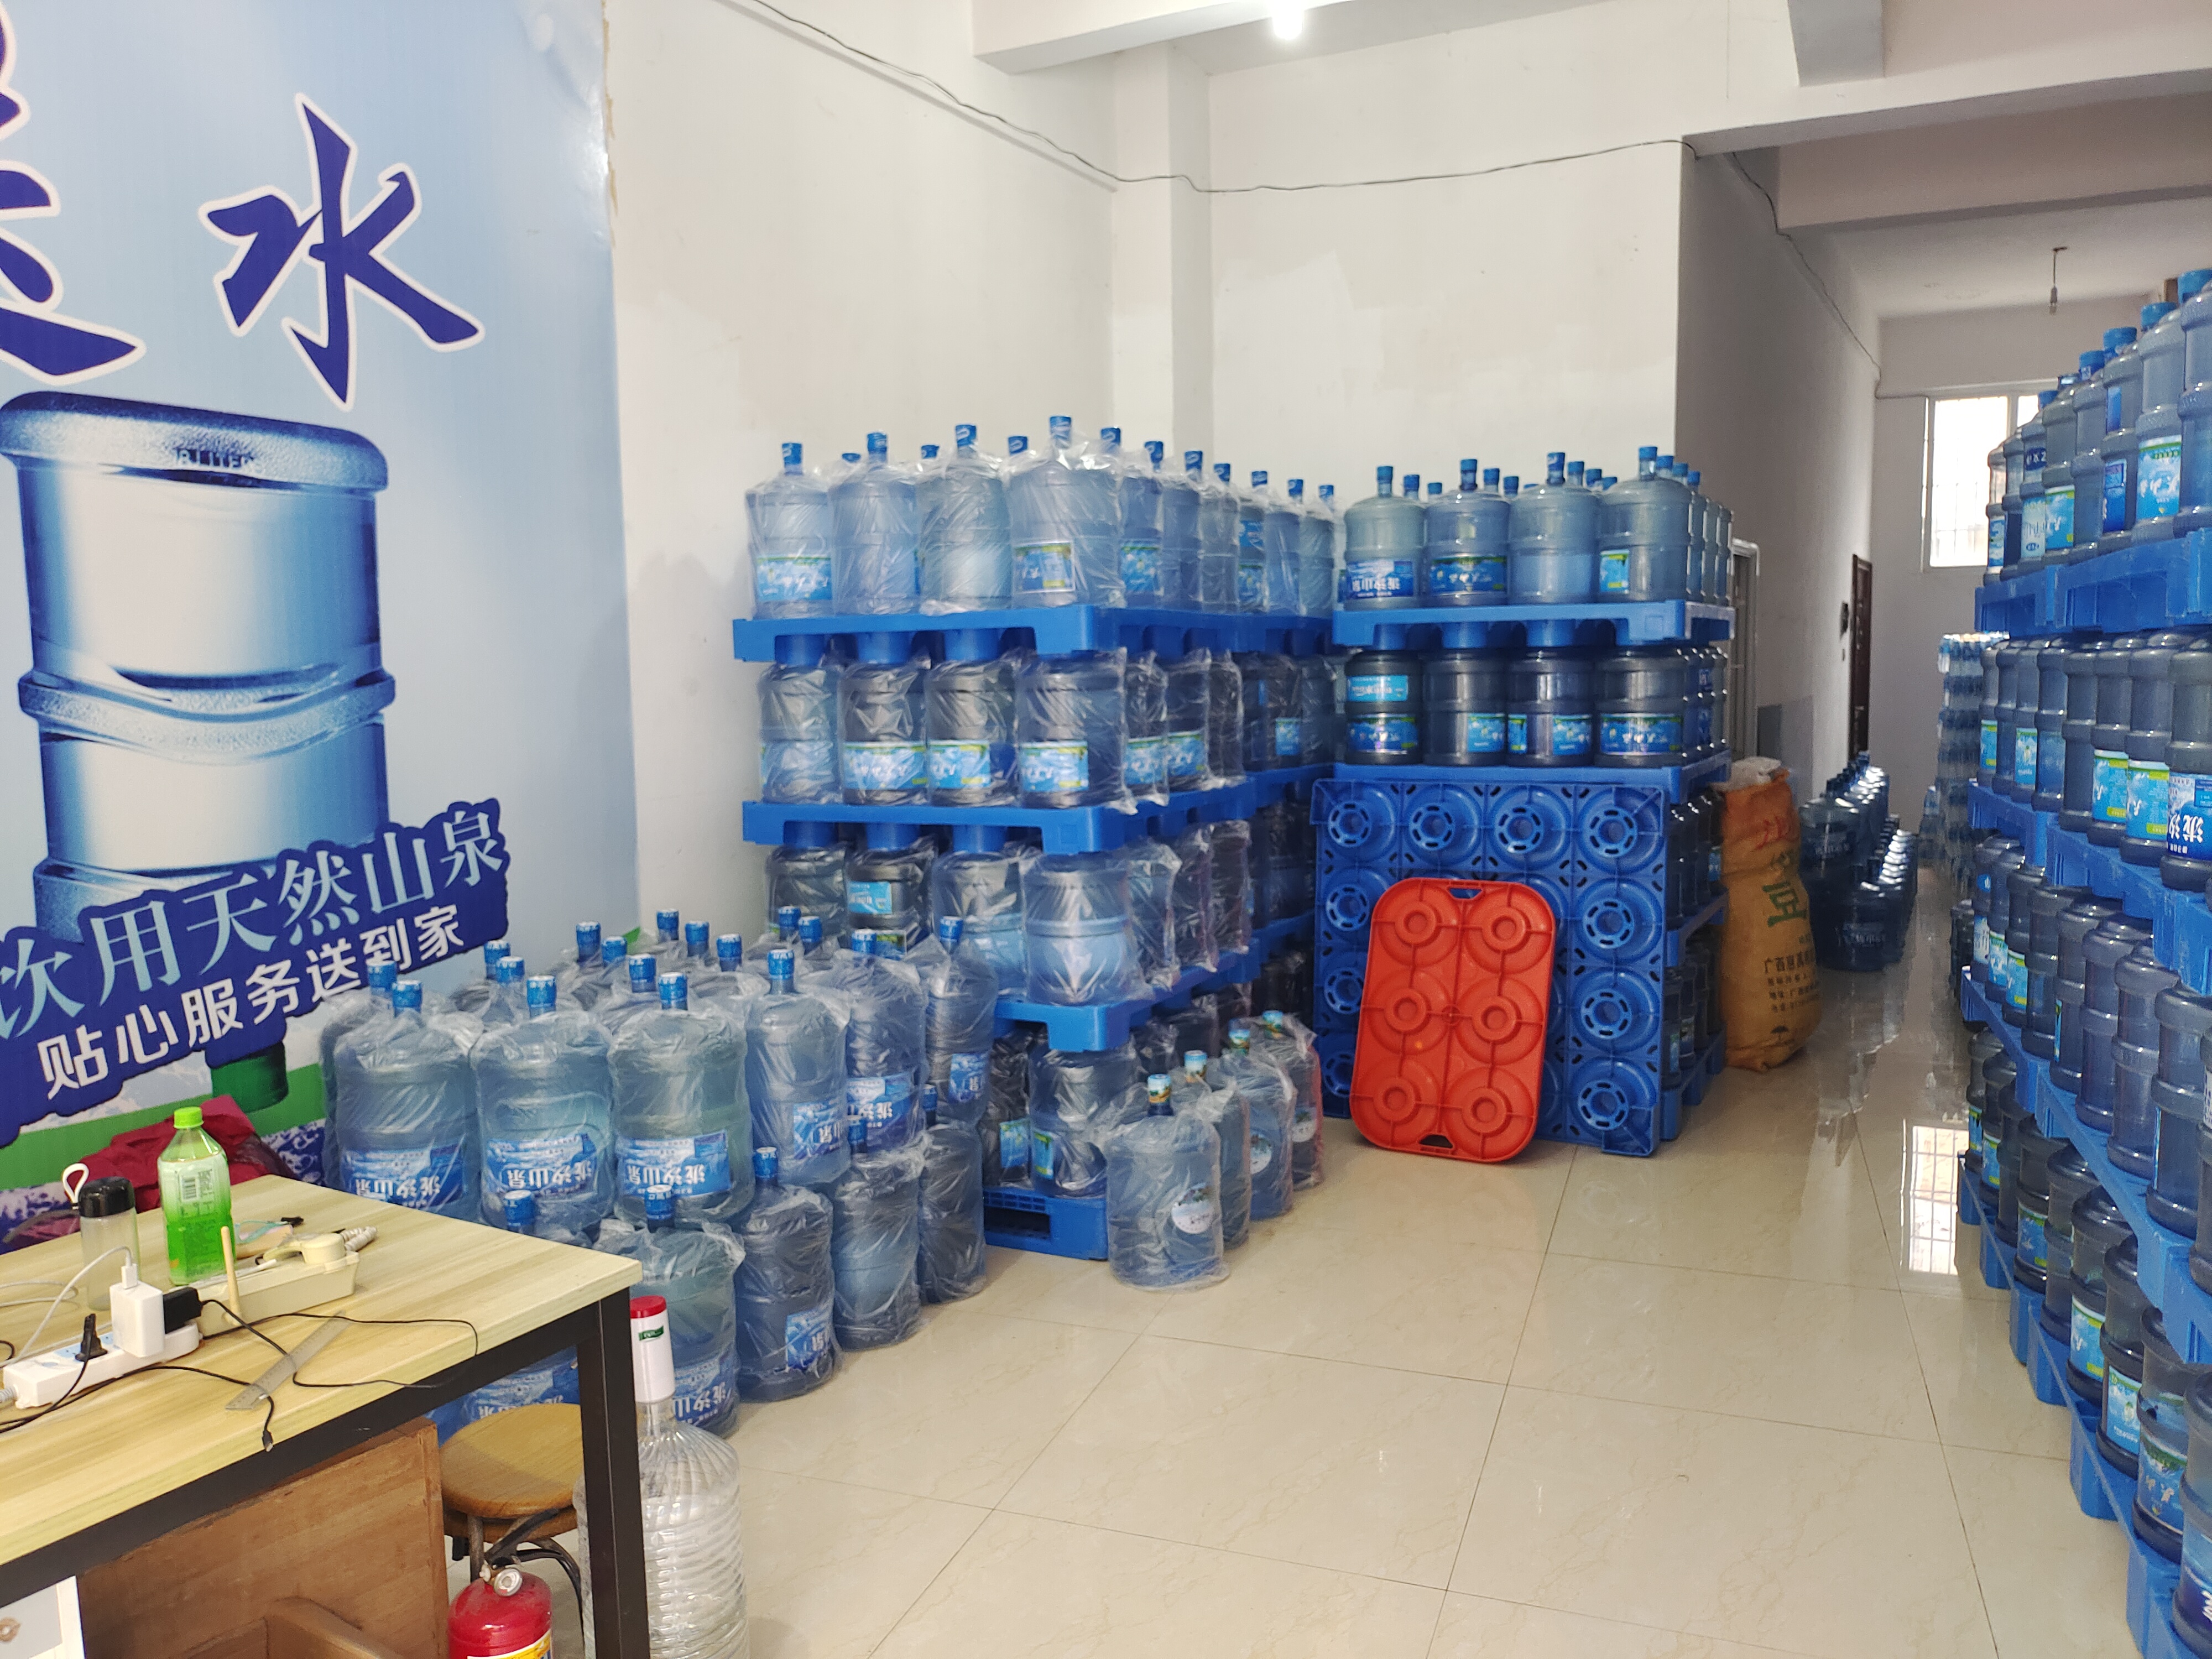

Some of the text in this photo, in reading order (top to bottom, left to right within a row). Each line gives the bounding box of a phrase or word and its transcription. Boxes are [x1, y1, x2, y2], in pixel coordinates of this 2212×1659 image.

[38, 905, 464, 1100] 贴心服务送到家
